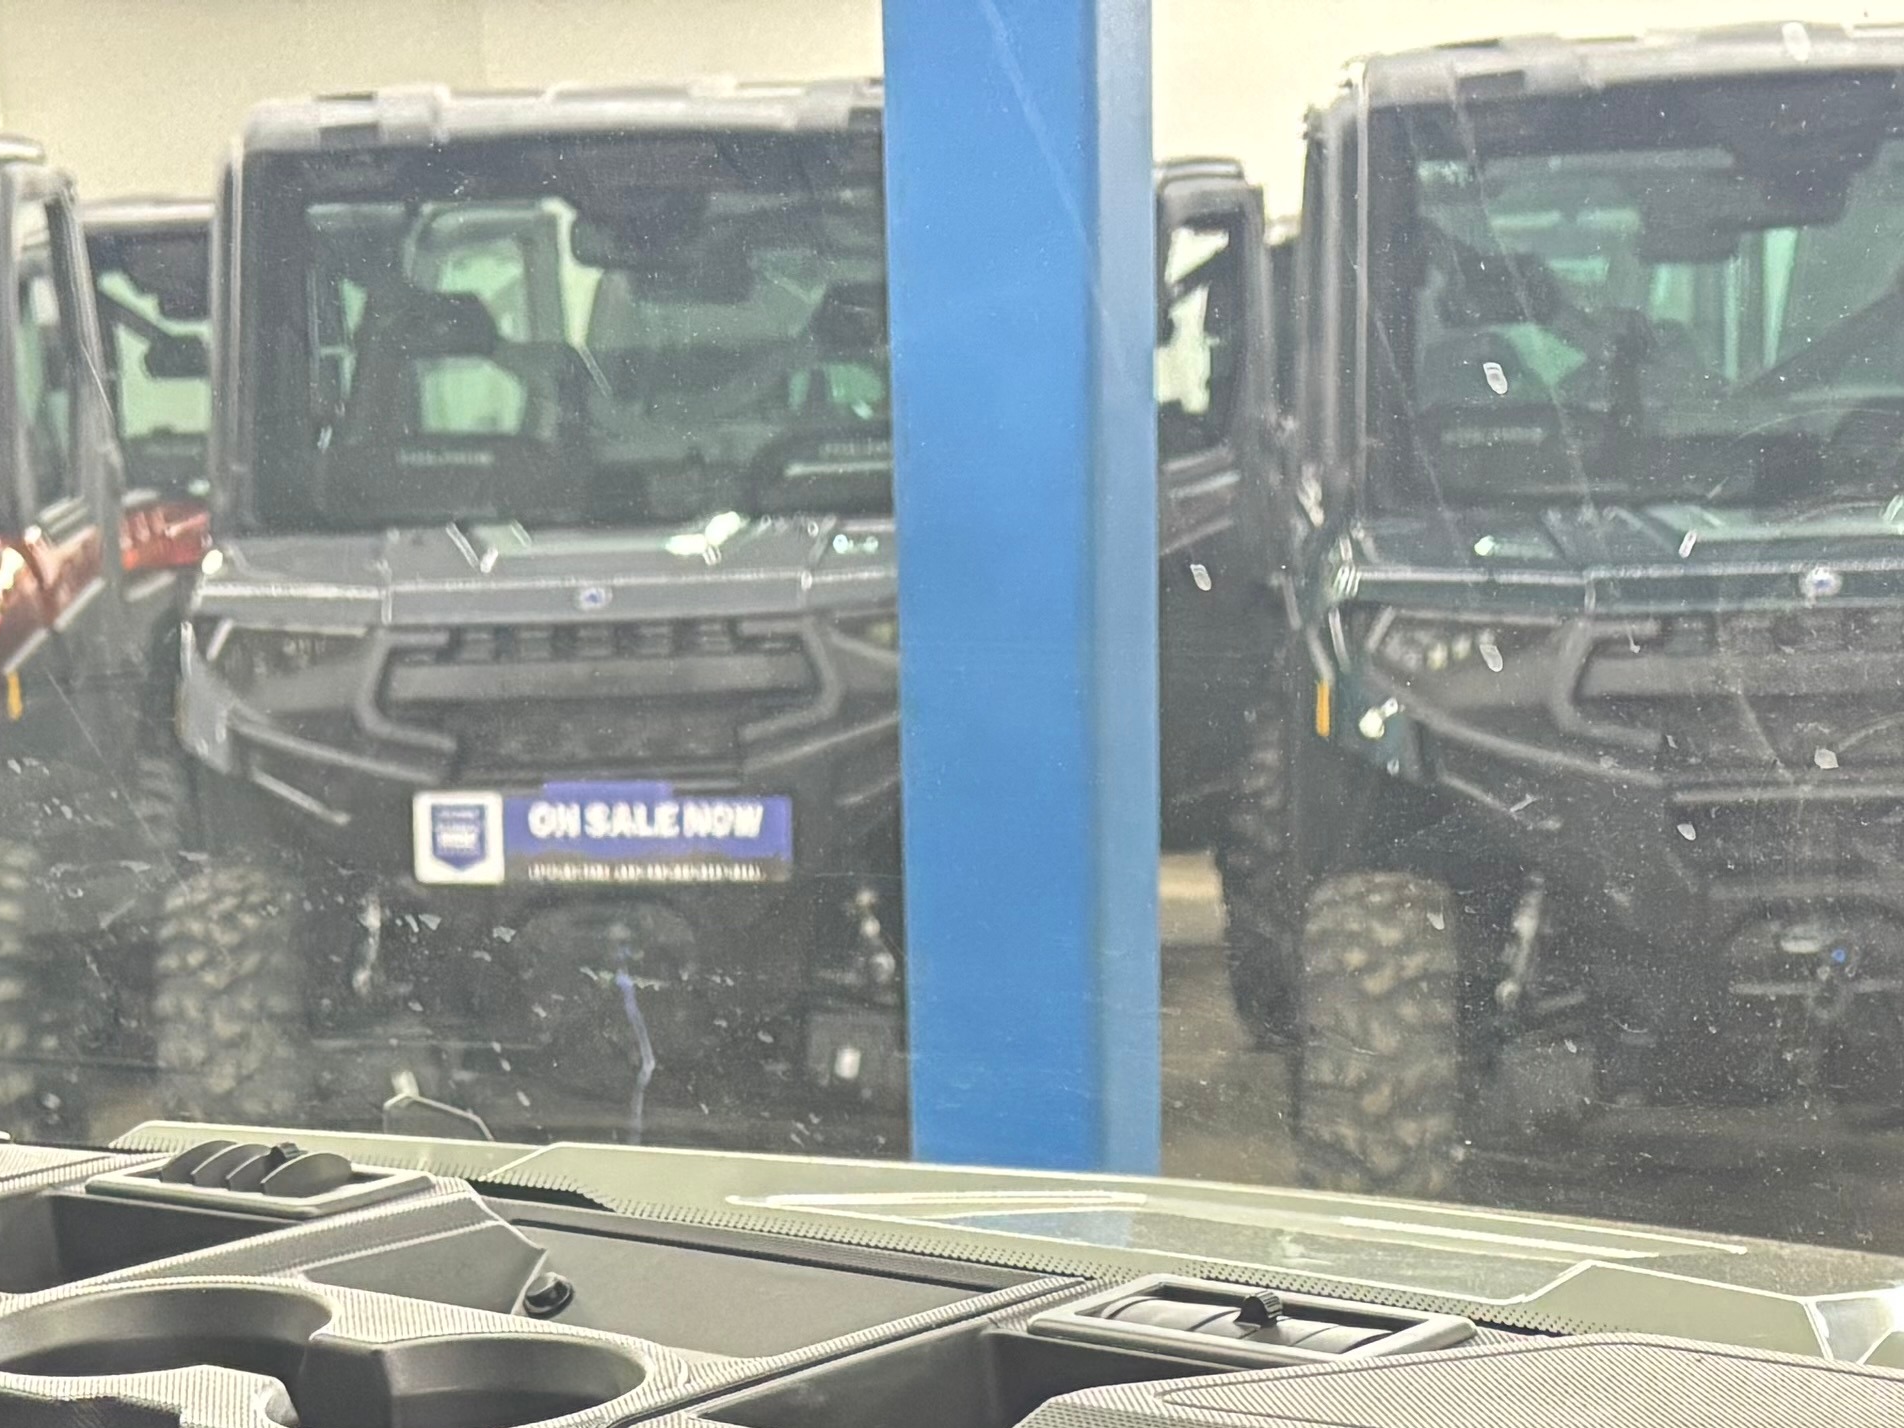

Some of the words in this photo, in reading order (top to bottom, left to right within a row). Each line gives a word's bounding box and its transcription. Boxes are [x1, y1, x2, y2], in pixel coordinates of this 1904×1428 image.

[528, 801, 581, 837] ON
[583, 800, 680, 838] SALE
[682, 802, 764, 838] NOW
